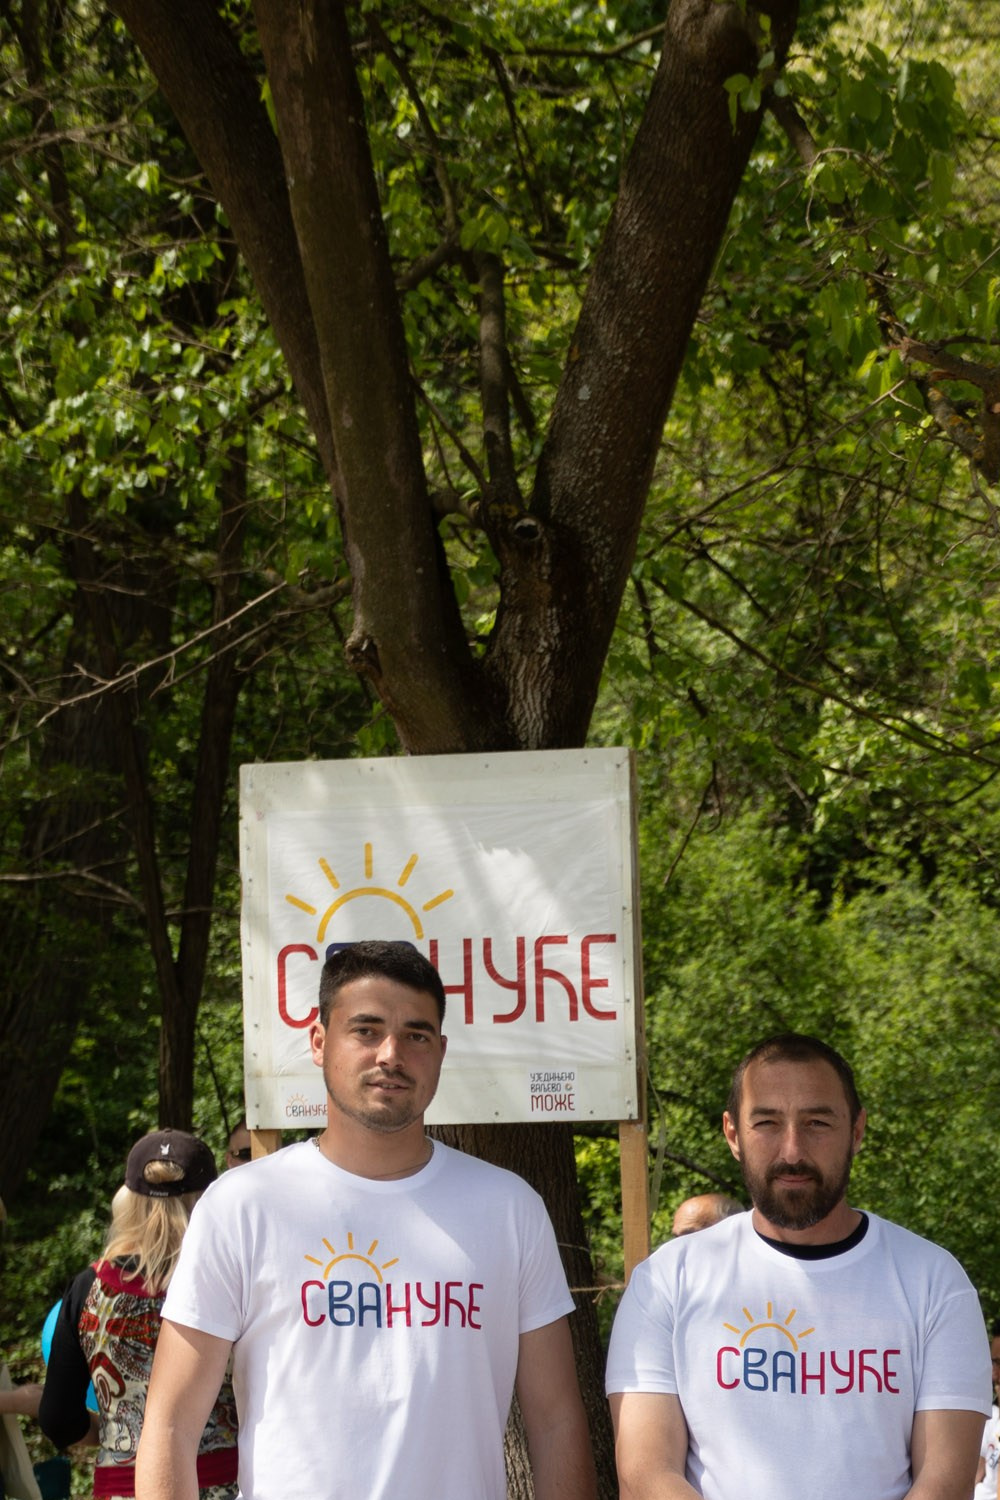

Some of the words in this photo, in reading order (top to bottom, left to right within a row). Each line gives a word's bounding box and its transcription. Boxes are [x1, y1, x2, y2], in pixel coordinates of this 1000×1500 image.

[277, 933, 617, 1029] СНУЋЕ
[530, 1072, 575, 1082] УЈЕДИЊЕНО
[530, 1083, 561, 1093] ВАЉЕВО
[531, 1094, 575, 1112] МОЖЕ
[300, 1280, 484, 1330] СВАНУЋЕ
[716, 1346, 901, 1395] СВАНУЋЕ
